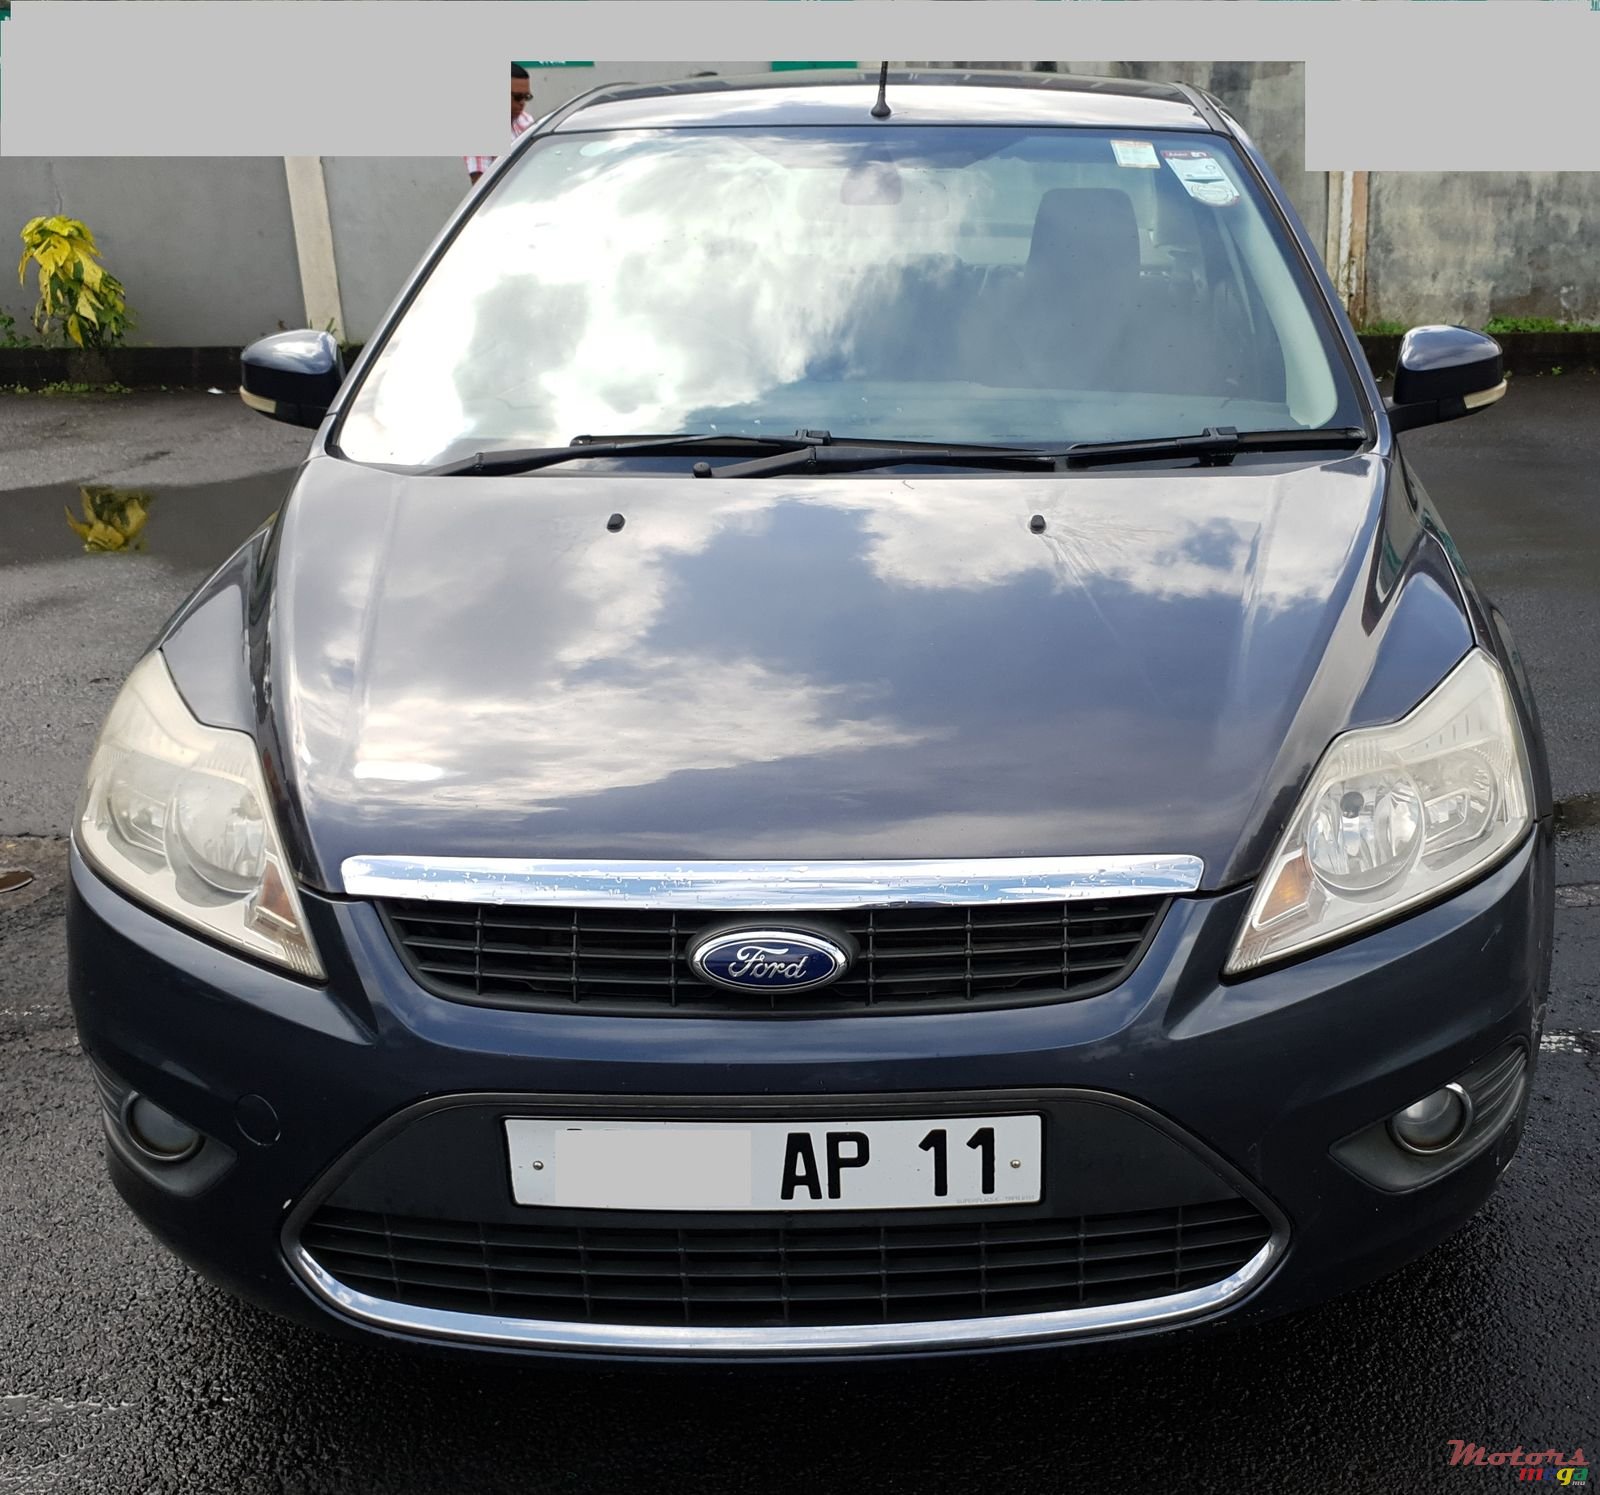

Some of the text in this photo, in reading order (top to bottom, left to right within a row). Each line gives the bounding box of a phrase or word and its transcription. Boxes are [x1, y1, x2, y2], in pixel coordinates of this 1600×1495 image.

[728, 945, 808, 978] Ford
[781, 1127, 995, 1200] AP 11
